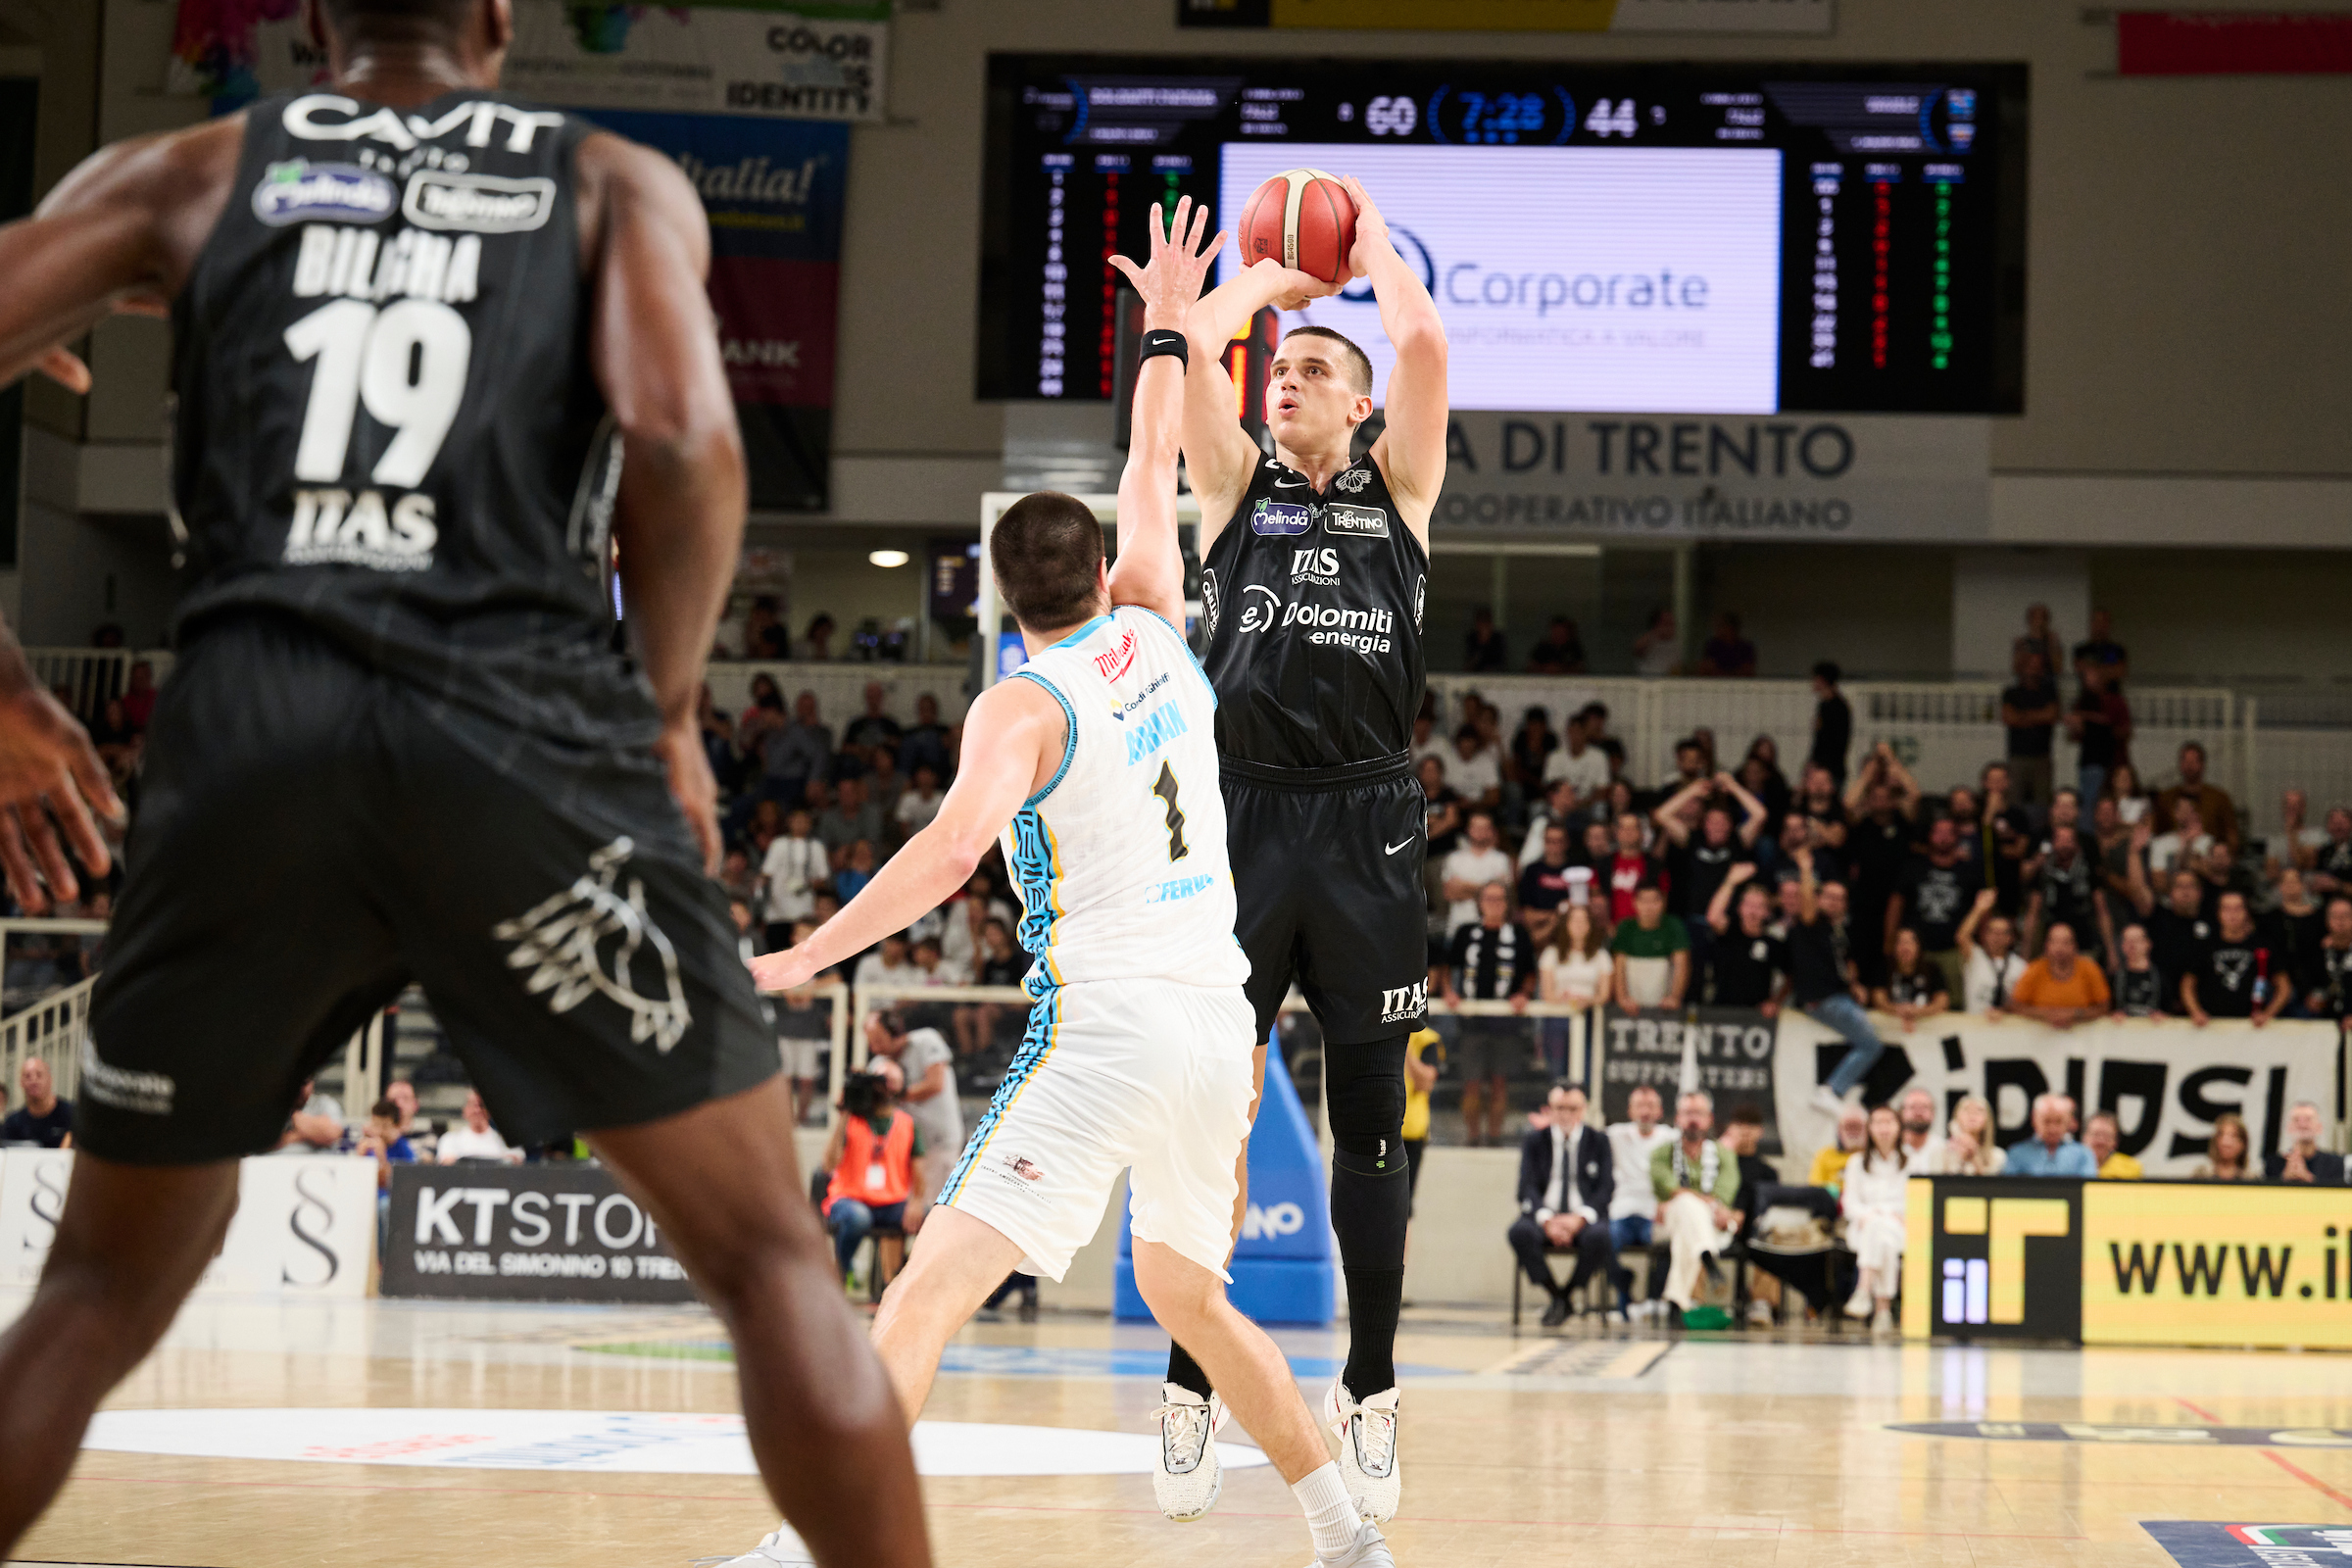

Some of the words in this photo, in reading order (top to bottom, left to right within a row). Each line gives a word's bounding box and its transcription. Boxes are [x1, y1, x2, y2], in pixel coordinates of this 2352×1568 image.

[282, 93, 565, 154] CAVIT
[1366, 95, 1418, 136] 60
[1585, 97, 1640, 138] 44
[1444, 260, 1711, 318] Corporate
[723, 339, 802, 370] ANK
[283, 297, 472, 489] 19
[1501, 421, 1565, 474] DI
[1588, 421, 1855, 479] TRENTO
[1253, 509, 1309, 527] Melinda
[1281, 601, 1394, 635] Dolomiti
[1309, 630, 1392, 654] energia
[1149, 756, 1191, 865] 1
[1608, 1018, 1772, 1059] TRENTO
[414, 1250, 452, 1274] VIA
[453, 1250, 497, 1275] DEL
[498, 1252, 607, 1279] SIMONINO
